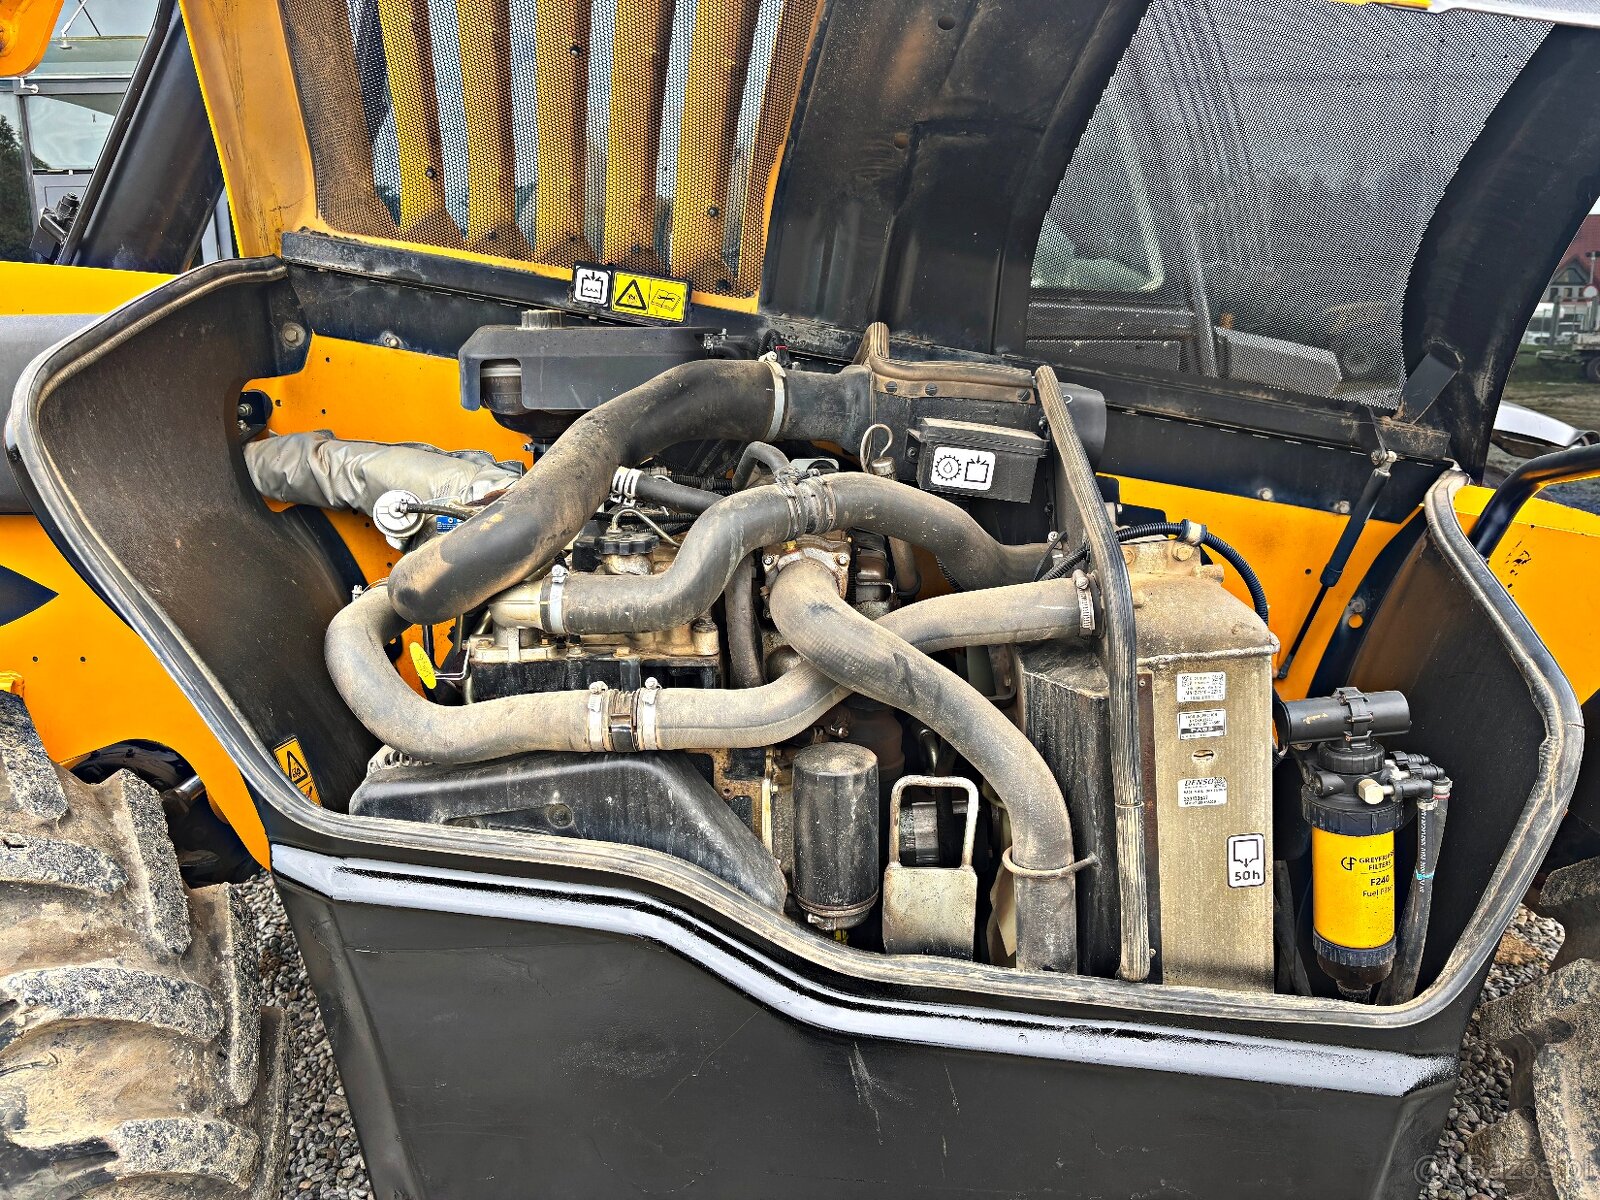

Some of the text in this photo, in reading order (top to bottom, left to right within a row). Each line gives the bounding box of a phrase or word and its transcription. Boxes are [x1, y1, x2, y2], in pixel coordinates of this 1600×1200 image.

[1184, 778, 1214, 787] DENSO
[1368, 860, 1391, 871] FILTERS
[1370, 874, 1390, 886] F240
[1362, 889, 1379, 897] Fuel
